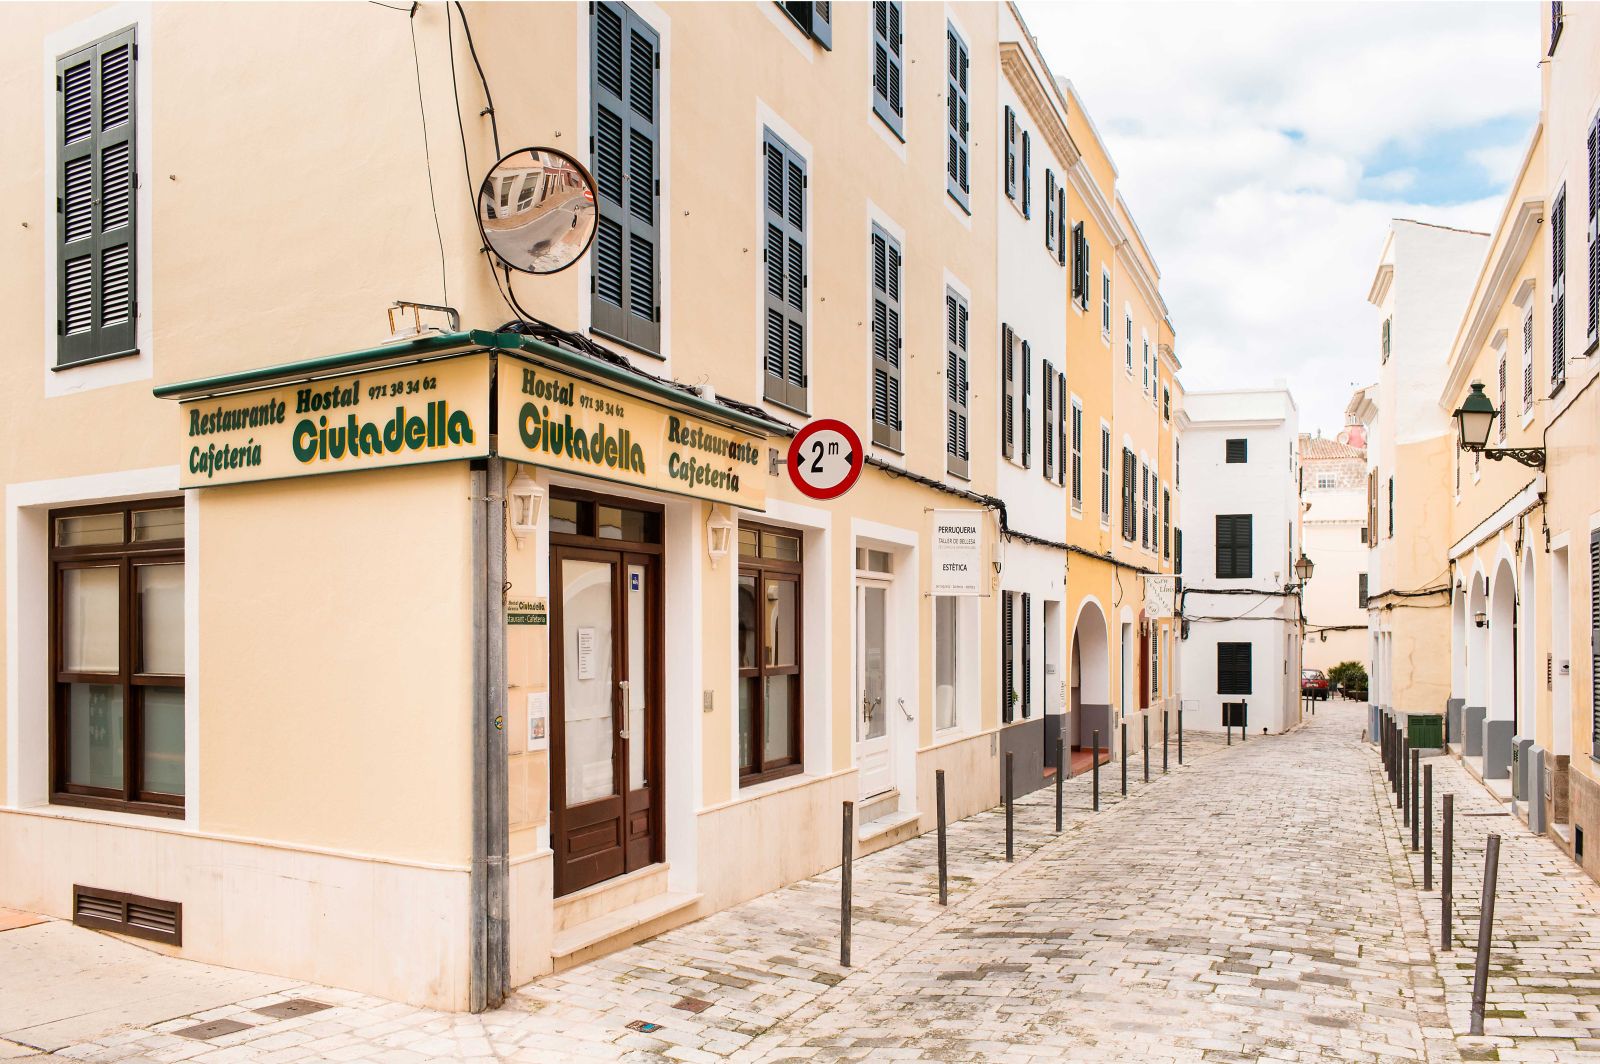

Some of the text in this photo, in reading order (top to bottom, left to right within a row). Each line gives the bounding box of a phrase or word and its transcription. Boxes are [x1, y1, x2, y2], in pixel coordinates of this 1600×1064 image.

[296, 376, 437, 414] Hostal 971 38 34 62
[521, 368, 624, 418] Hostal 971 38 34 62
[189, 398, 286, 437] Restaurante
[292, 400, 476, 465] Ciutadella
[518, 401, 646, 475] Ciutadella
[189, 437, 262, 478] Cafetería
[668, 415, 759, 466] Restaurante
[810, 440, 839, 473] 2 m
[668, 452, 740, 493] Cafetería
[938, 526, 976, 534] PERRUQUERIA
